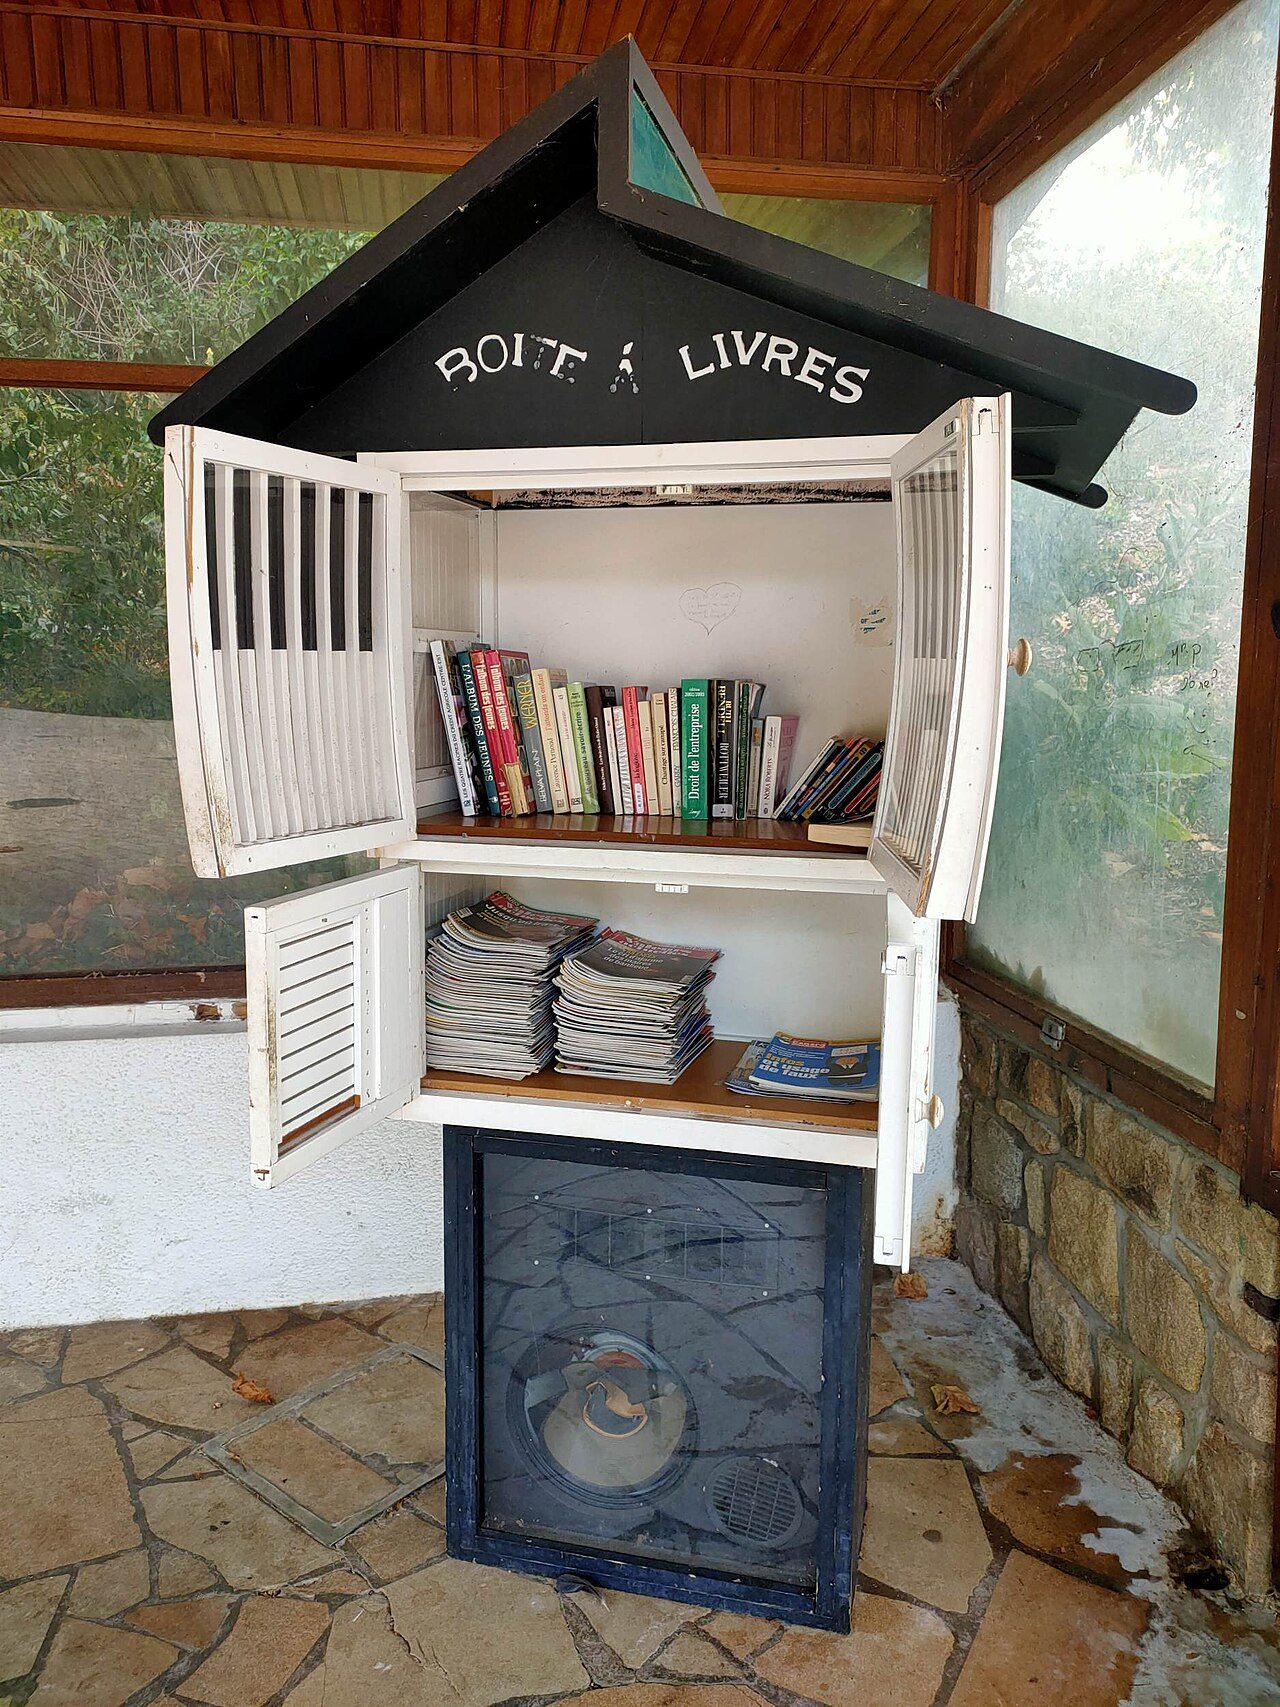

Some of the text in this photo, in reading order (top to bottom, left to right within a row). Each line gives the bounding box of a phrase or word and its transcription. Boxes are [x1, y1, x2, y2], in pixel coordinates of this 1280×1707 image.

[678, 330, 871, 404] LIVRES
[481, 690, 492, 704] des
[495, 690, 506, 705] des
[518, 679, 538, 729] WERNER
[460, 663, 494, 781] L'ALBUM DES JEUNES
[717, 685, 726, 737] RENDELL
[687, 703, 702, 757] l'entreprise
[532, 749, 547, 802] BELVA PLAIN
[551, 764, 561, 792] Laurence
[659, 757, 669, 784] Chantage
[687, 760, 699, 771] de
[717, 742, 729, 798] ROTTWEILER
[687, 774, 699, 799] Droit
[760, 1064, 819, 1079] de faux
[766, 1053, 804, 1066] Infos
[781, 1064, 831, 1074] usage
